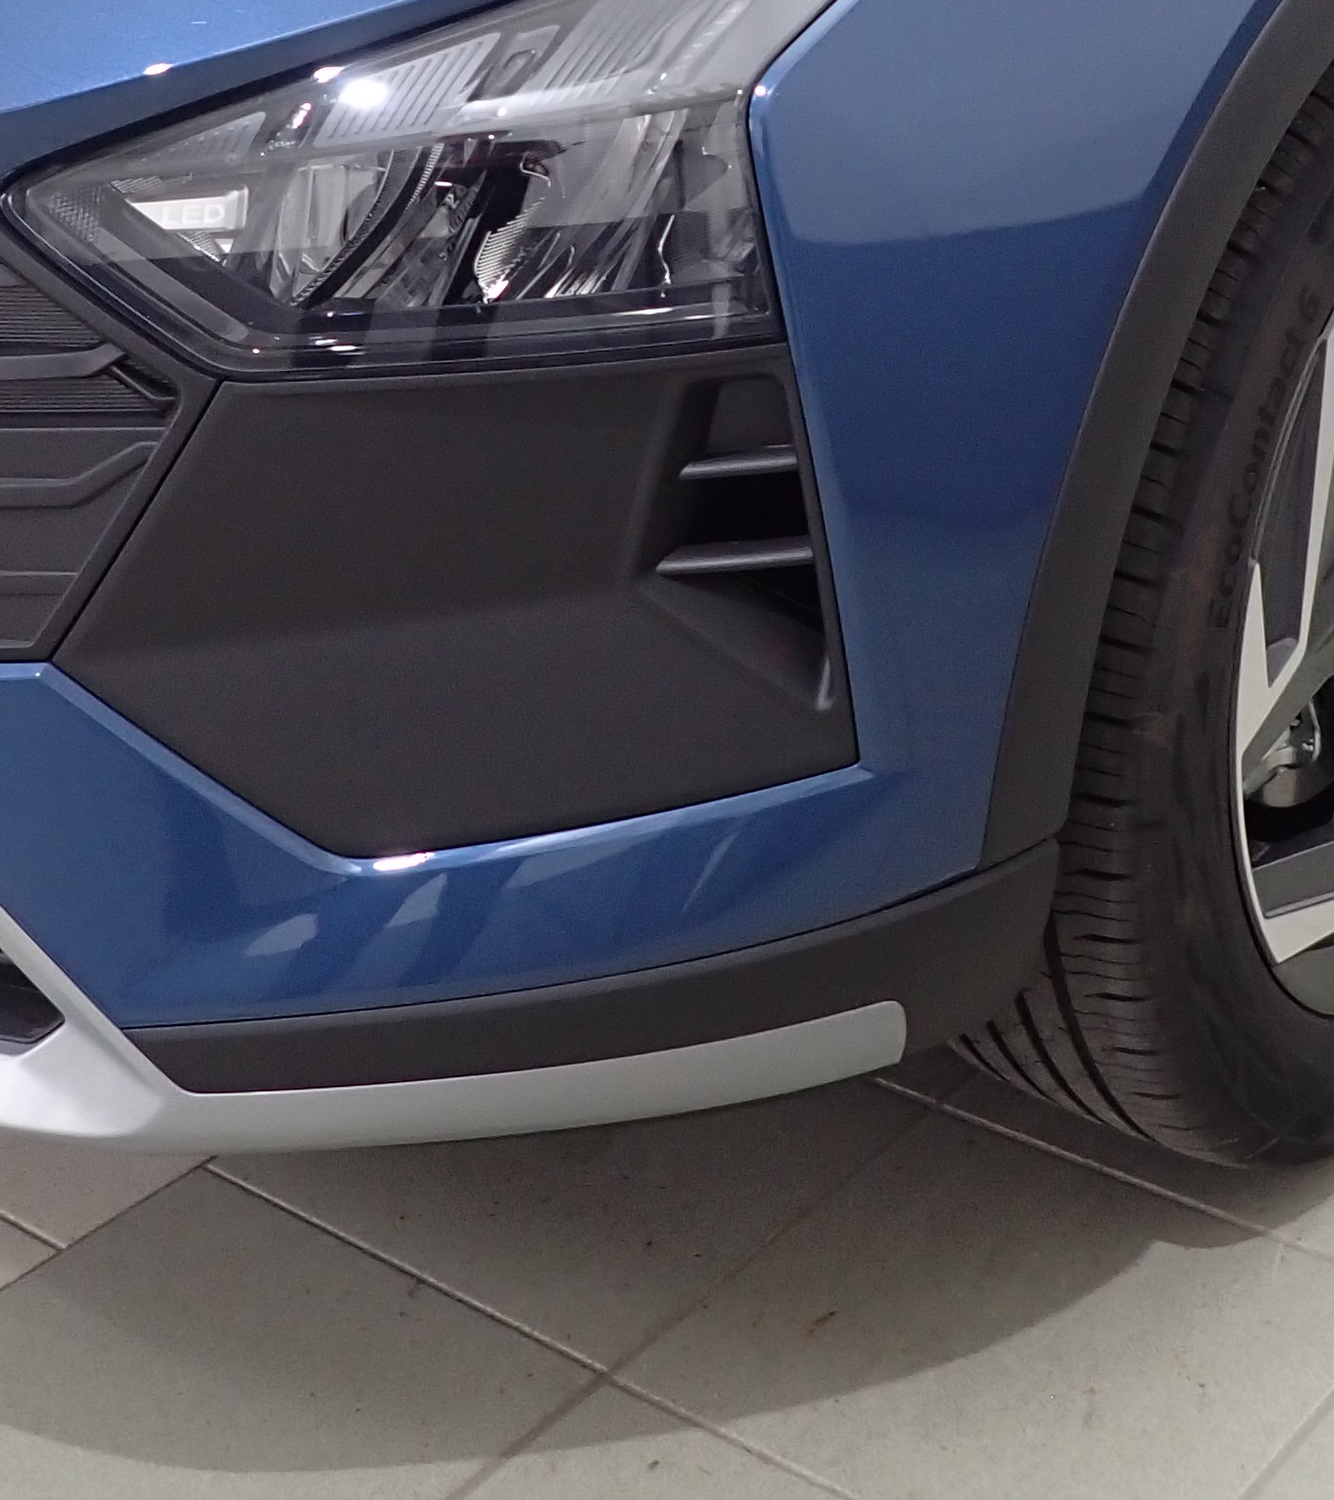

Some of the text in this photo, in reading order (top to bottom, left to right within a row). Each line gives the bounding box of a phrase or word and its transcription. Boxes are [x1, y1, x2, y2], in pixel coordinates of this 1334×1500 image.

[162, 203, 226, 226] LED
[1208, 282, 1322, 629] EcoContact 6
